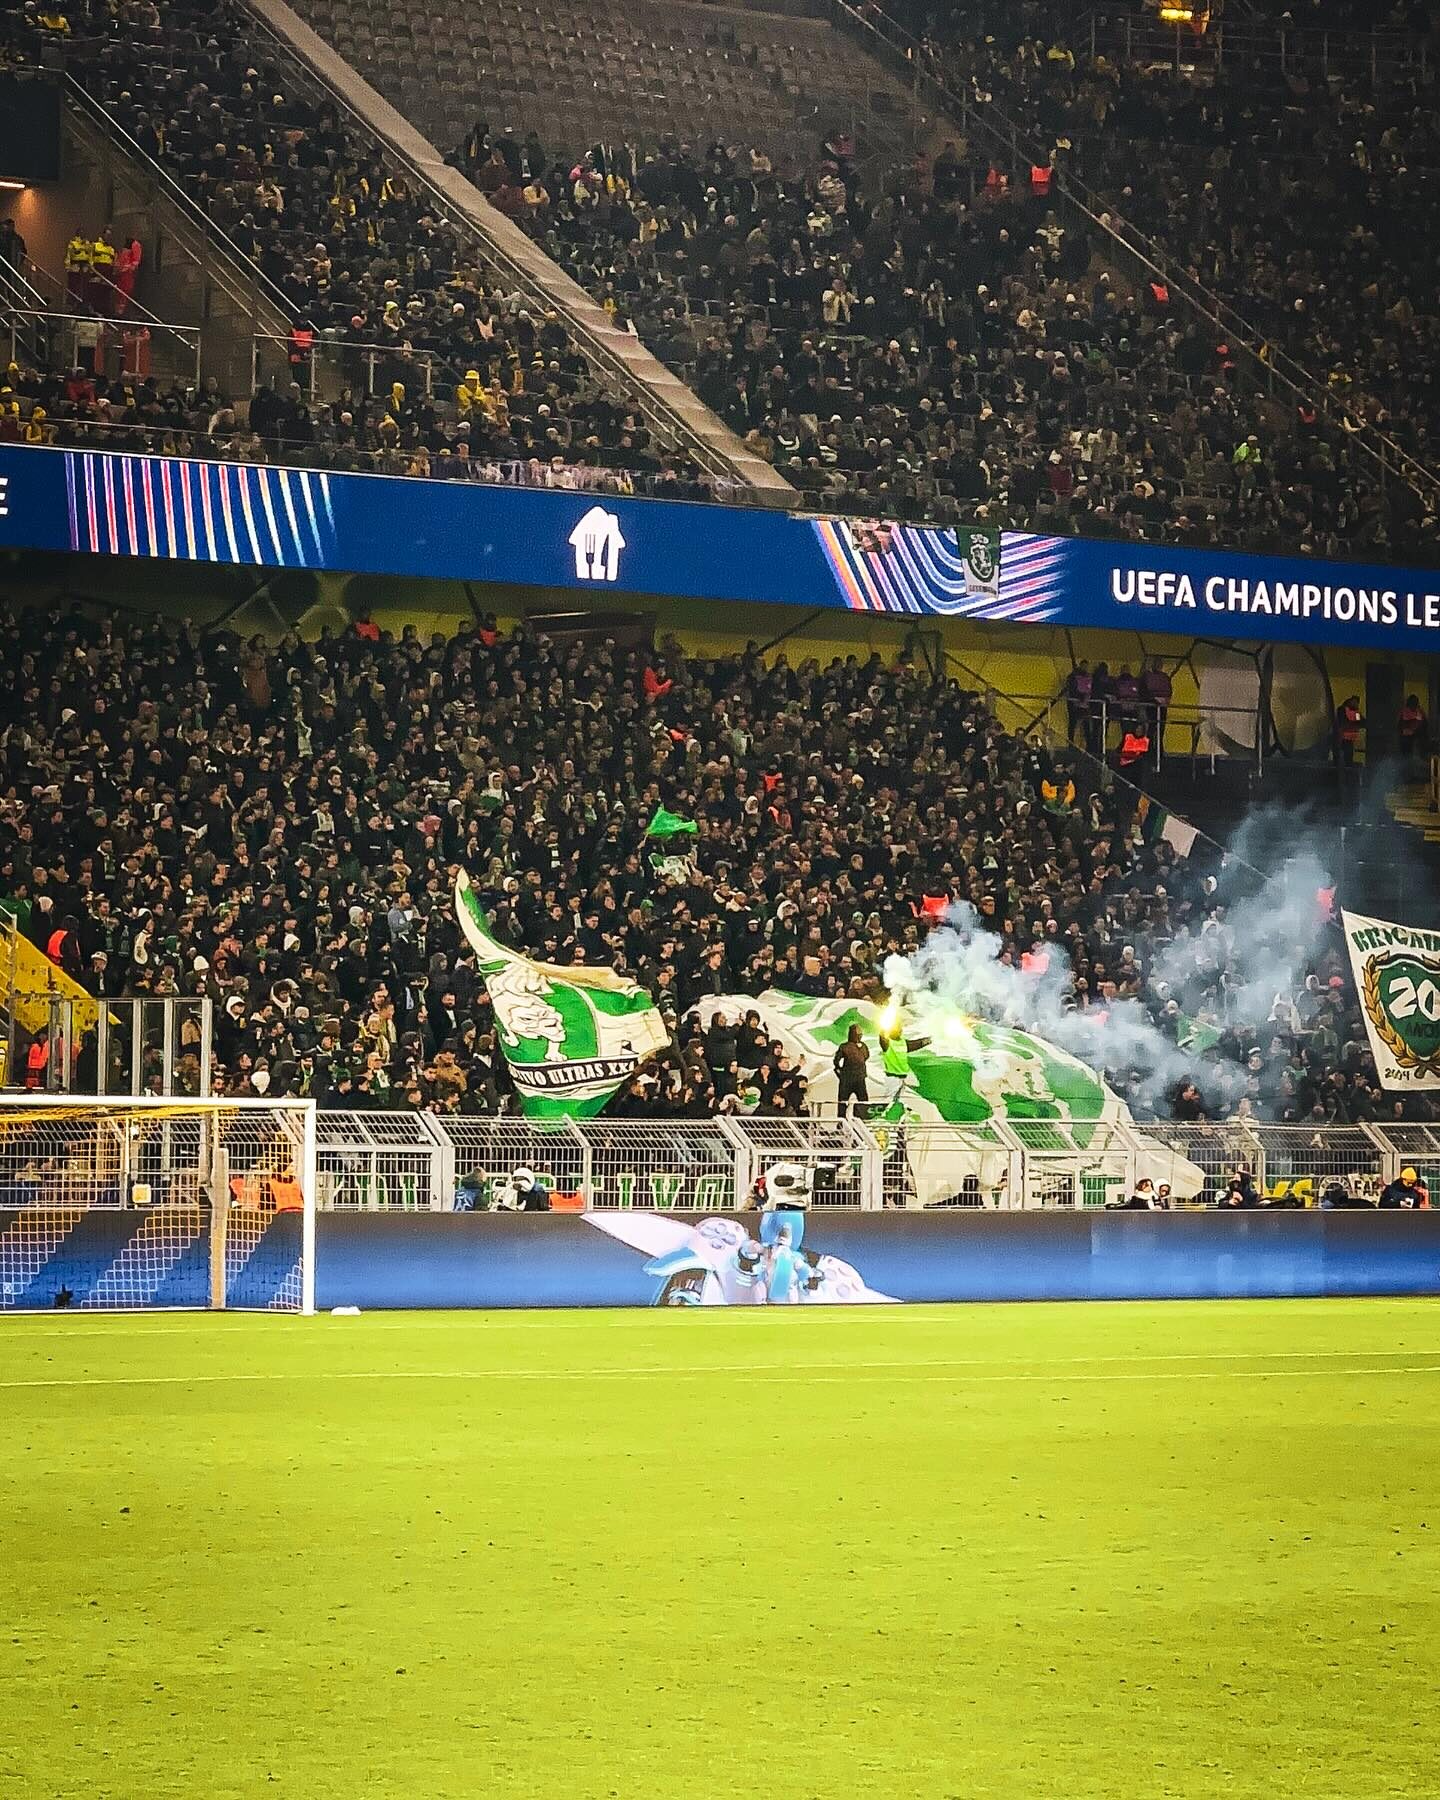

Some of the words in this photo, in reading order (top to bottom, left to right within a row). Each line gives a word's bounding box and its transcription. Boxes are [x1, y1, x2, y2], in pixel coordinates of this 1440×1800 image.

[1112, 568, 1197, 608] UEFA
[1205, 576, 1398, 624] CHAMPIONS
[1406, 593, 1440, 627] LE
[547, 1062, 605, 1085] ULTRAS
